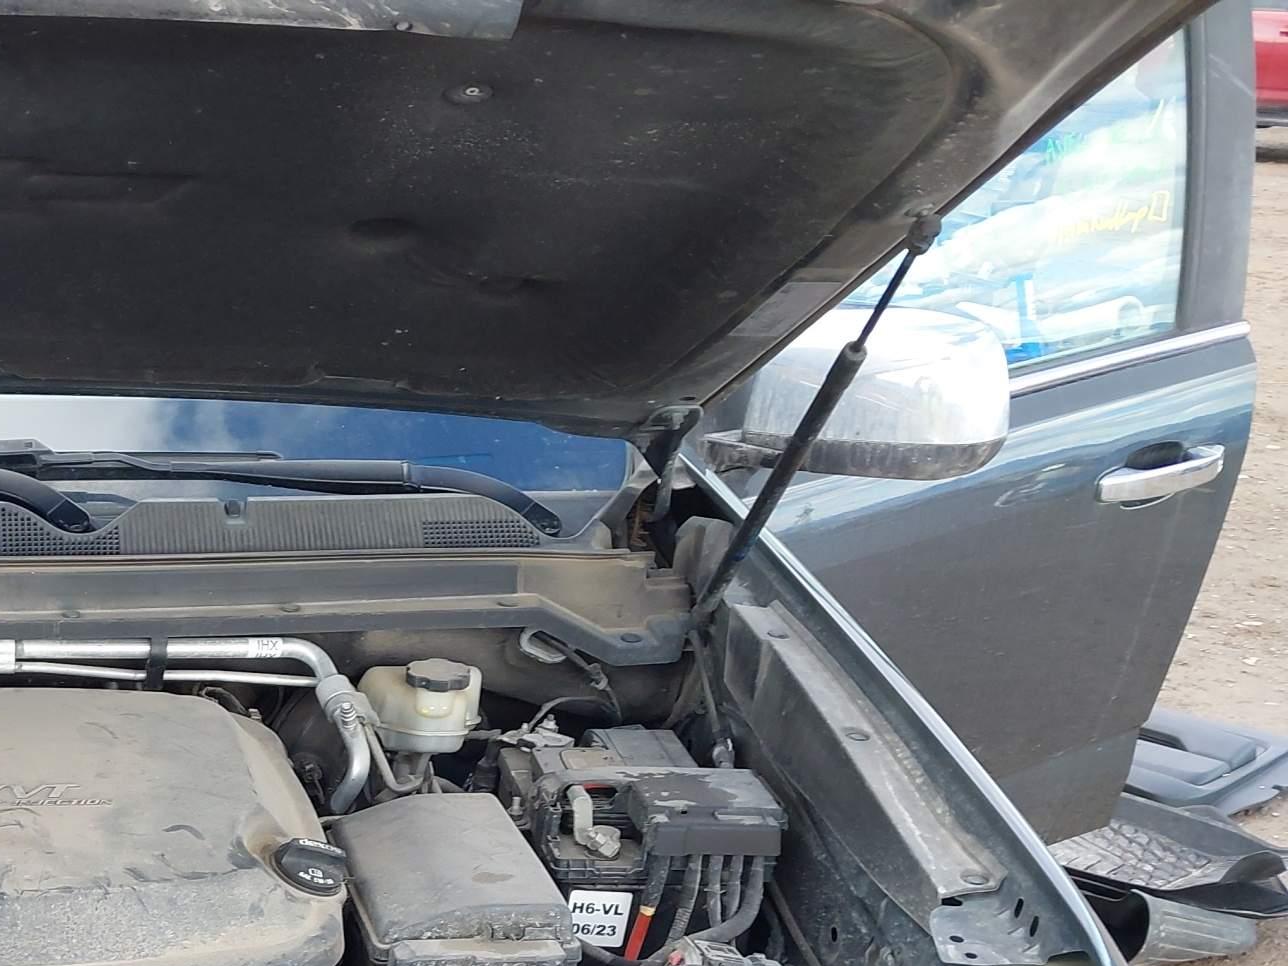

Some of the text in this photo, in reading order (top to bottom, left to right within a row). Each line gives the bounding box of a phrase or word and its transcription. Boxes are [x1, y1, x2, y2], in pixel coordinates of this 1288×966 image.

[14, 799, 114, 808] INJECTION
[572, 902, 624, 916] H6-VL
[572, 923, 617, 937] 06/23
